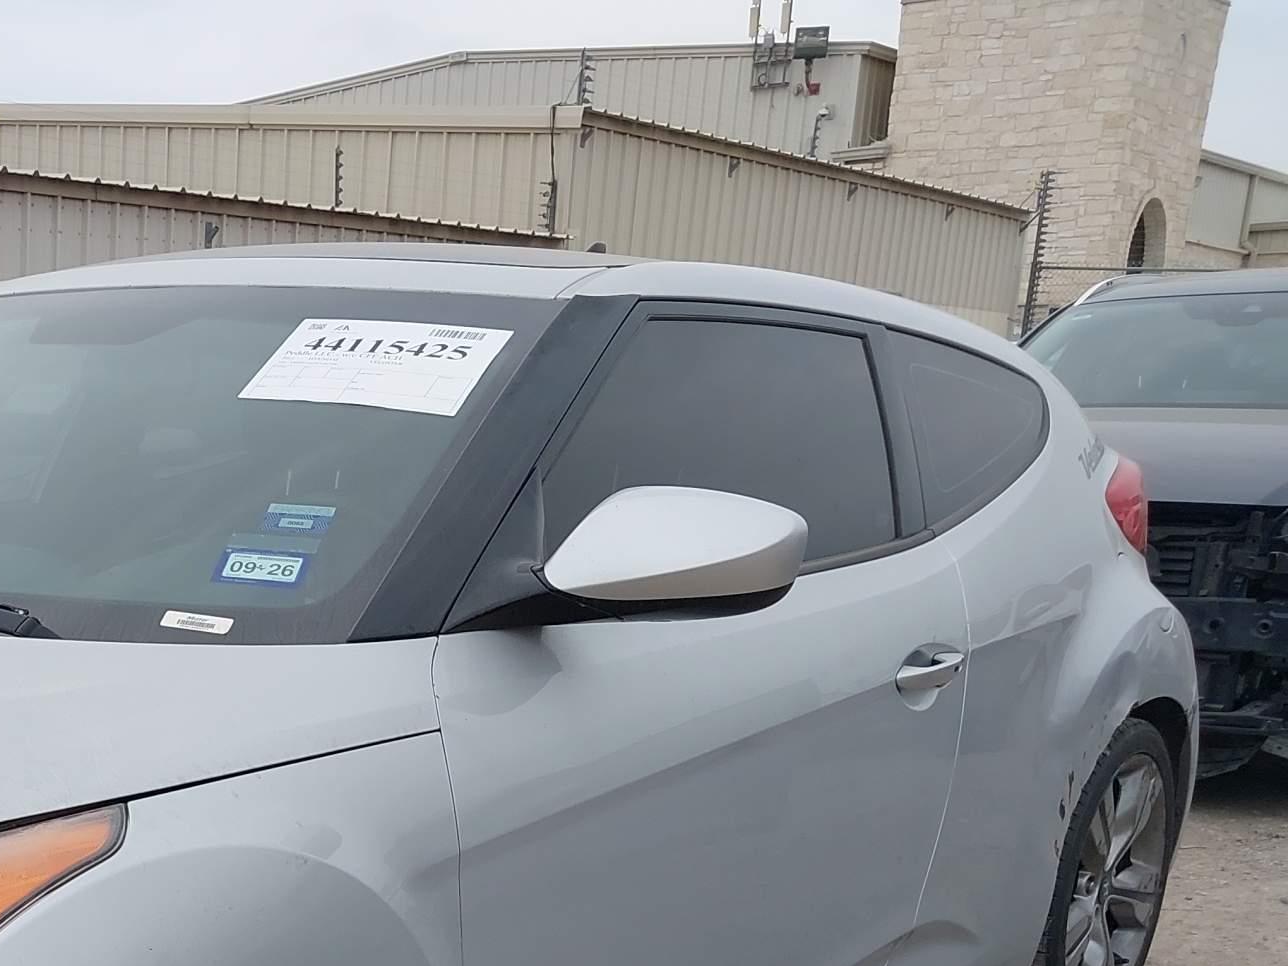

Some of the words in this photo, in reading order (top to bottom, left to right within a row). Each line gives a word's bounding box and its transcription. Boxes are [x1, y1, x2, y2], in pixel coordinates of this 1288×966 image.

[303, 336, 473, 361] 44115425
[229, 560, 257, 574] 09
[266, 563, 295, 577] 26
